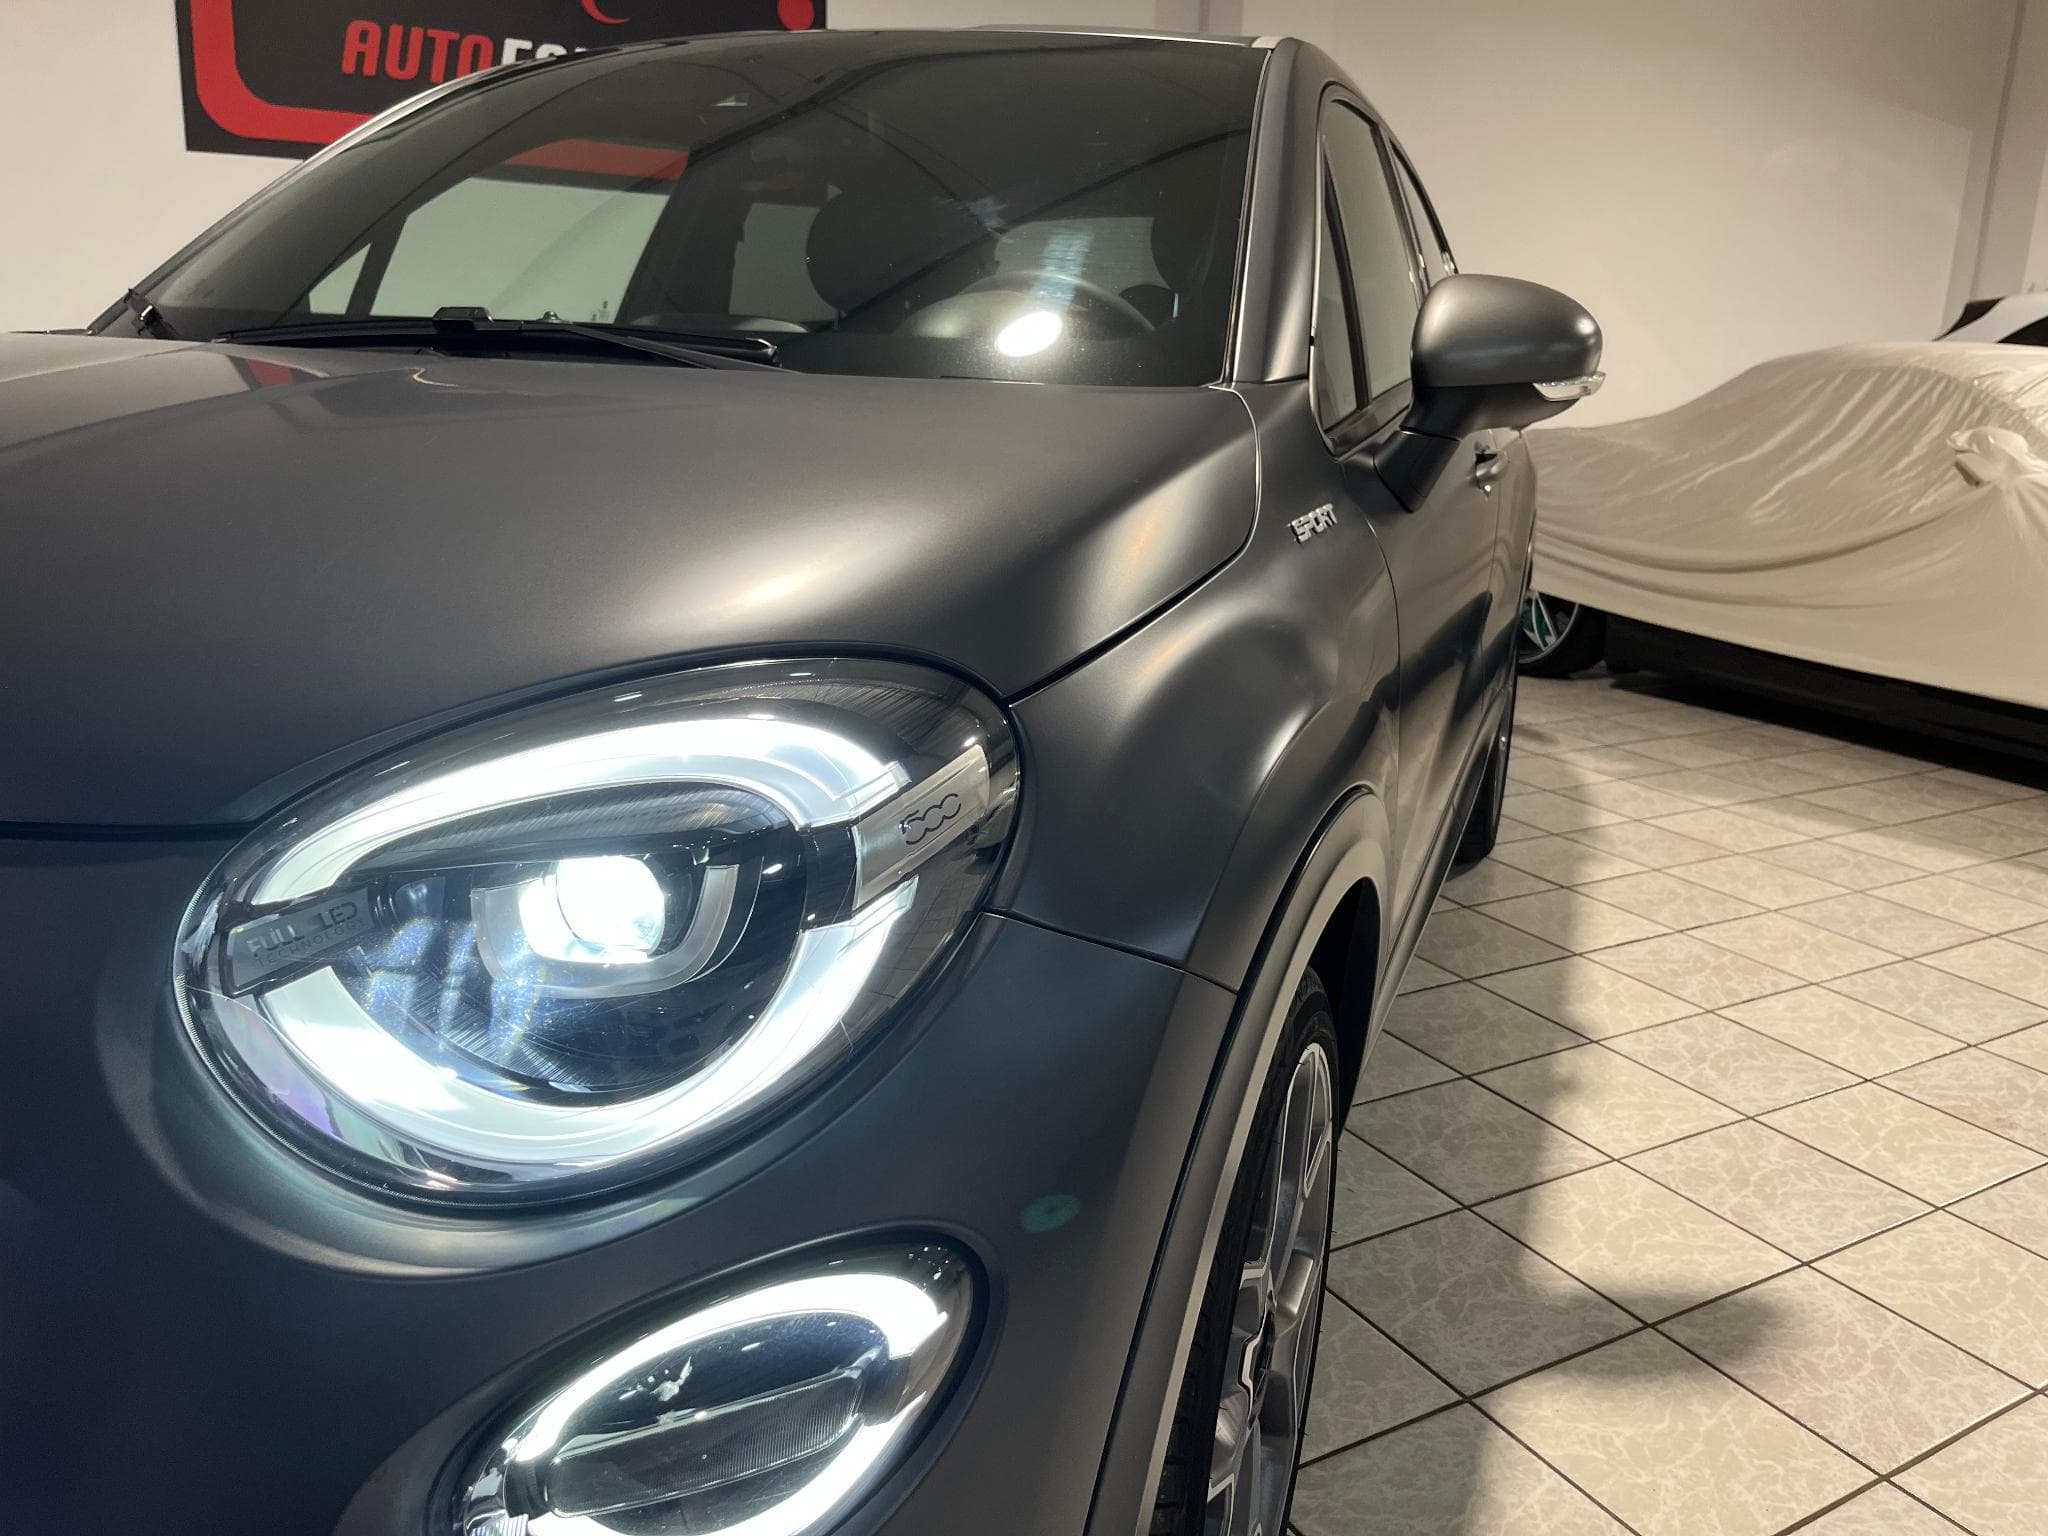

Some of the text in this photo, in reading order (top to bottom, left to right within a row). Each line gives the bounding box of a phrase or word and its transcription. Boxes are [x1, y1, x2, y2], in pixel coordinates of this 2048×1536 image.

[1291, 503, 1338, 543] SPORT
[899, 793, 961, 845] 500
[246, 901, 358, 953] FULL LED
